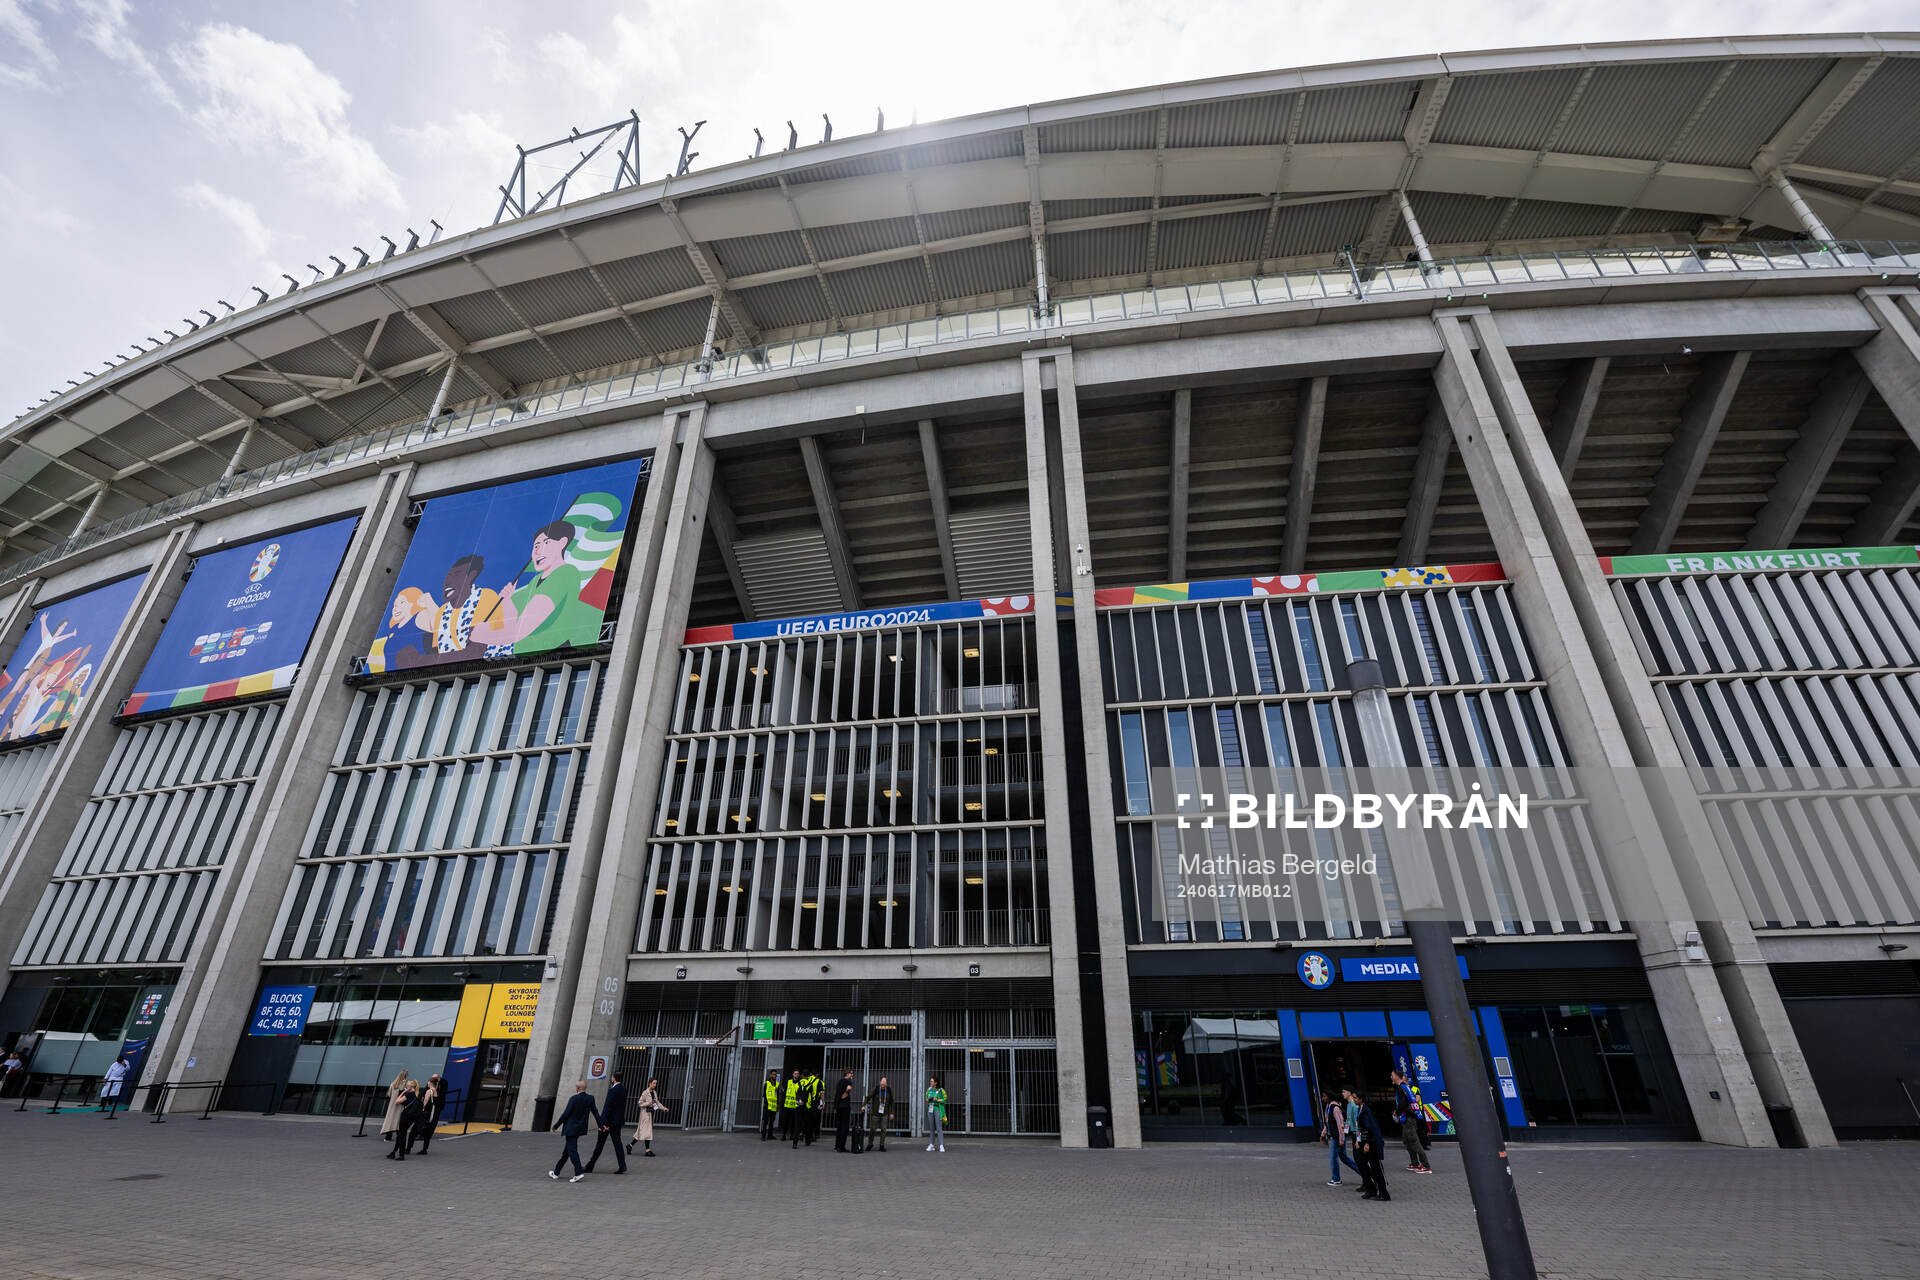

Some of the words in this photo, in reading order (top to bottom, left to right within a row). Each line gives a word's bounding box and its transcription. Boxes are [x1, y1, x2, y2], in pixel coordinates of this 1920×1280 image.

[1665, 552, 1863, 574] FRANKFURT
[1361, 963, 1411, 975] MEDIA
[604, 976, 618, 992] 05
[269, 993, 303, 1004] BLOCKS
[600, 1000, 615, 1015] 03
[286, 1019, 298, 1029] 2A
[811, 1017, 838, 1025] Eingang
